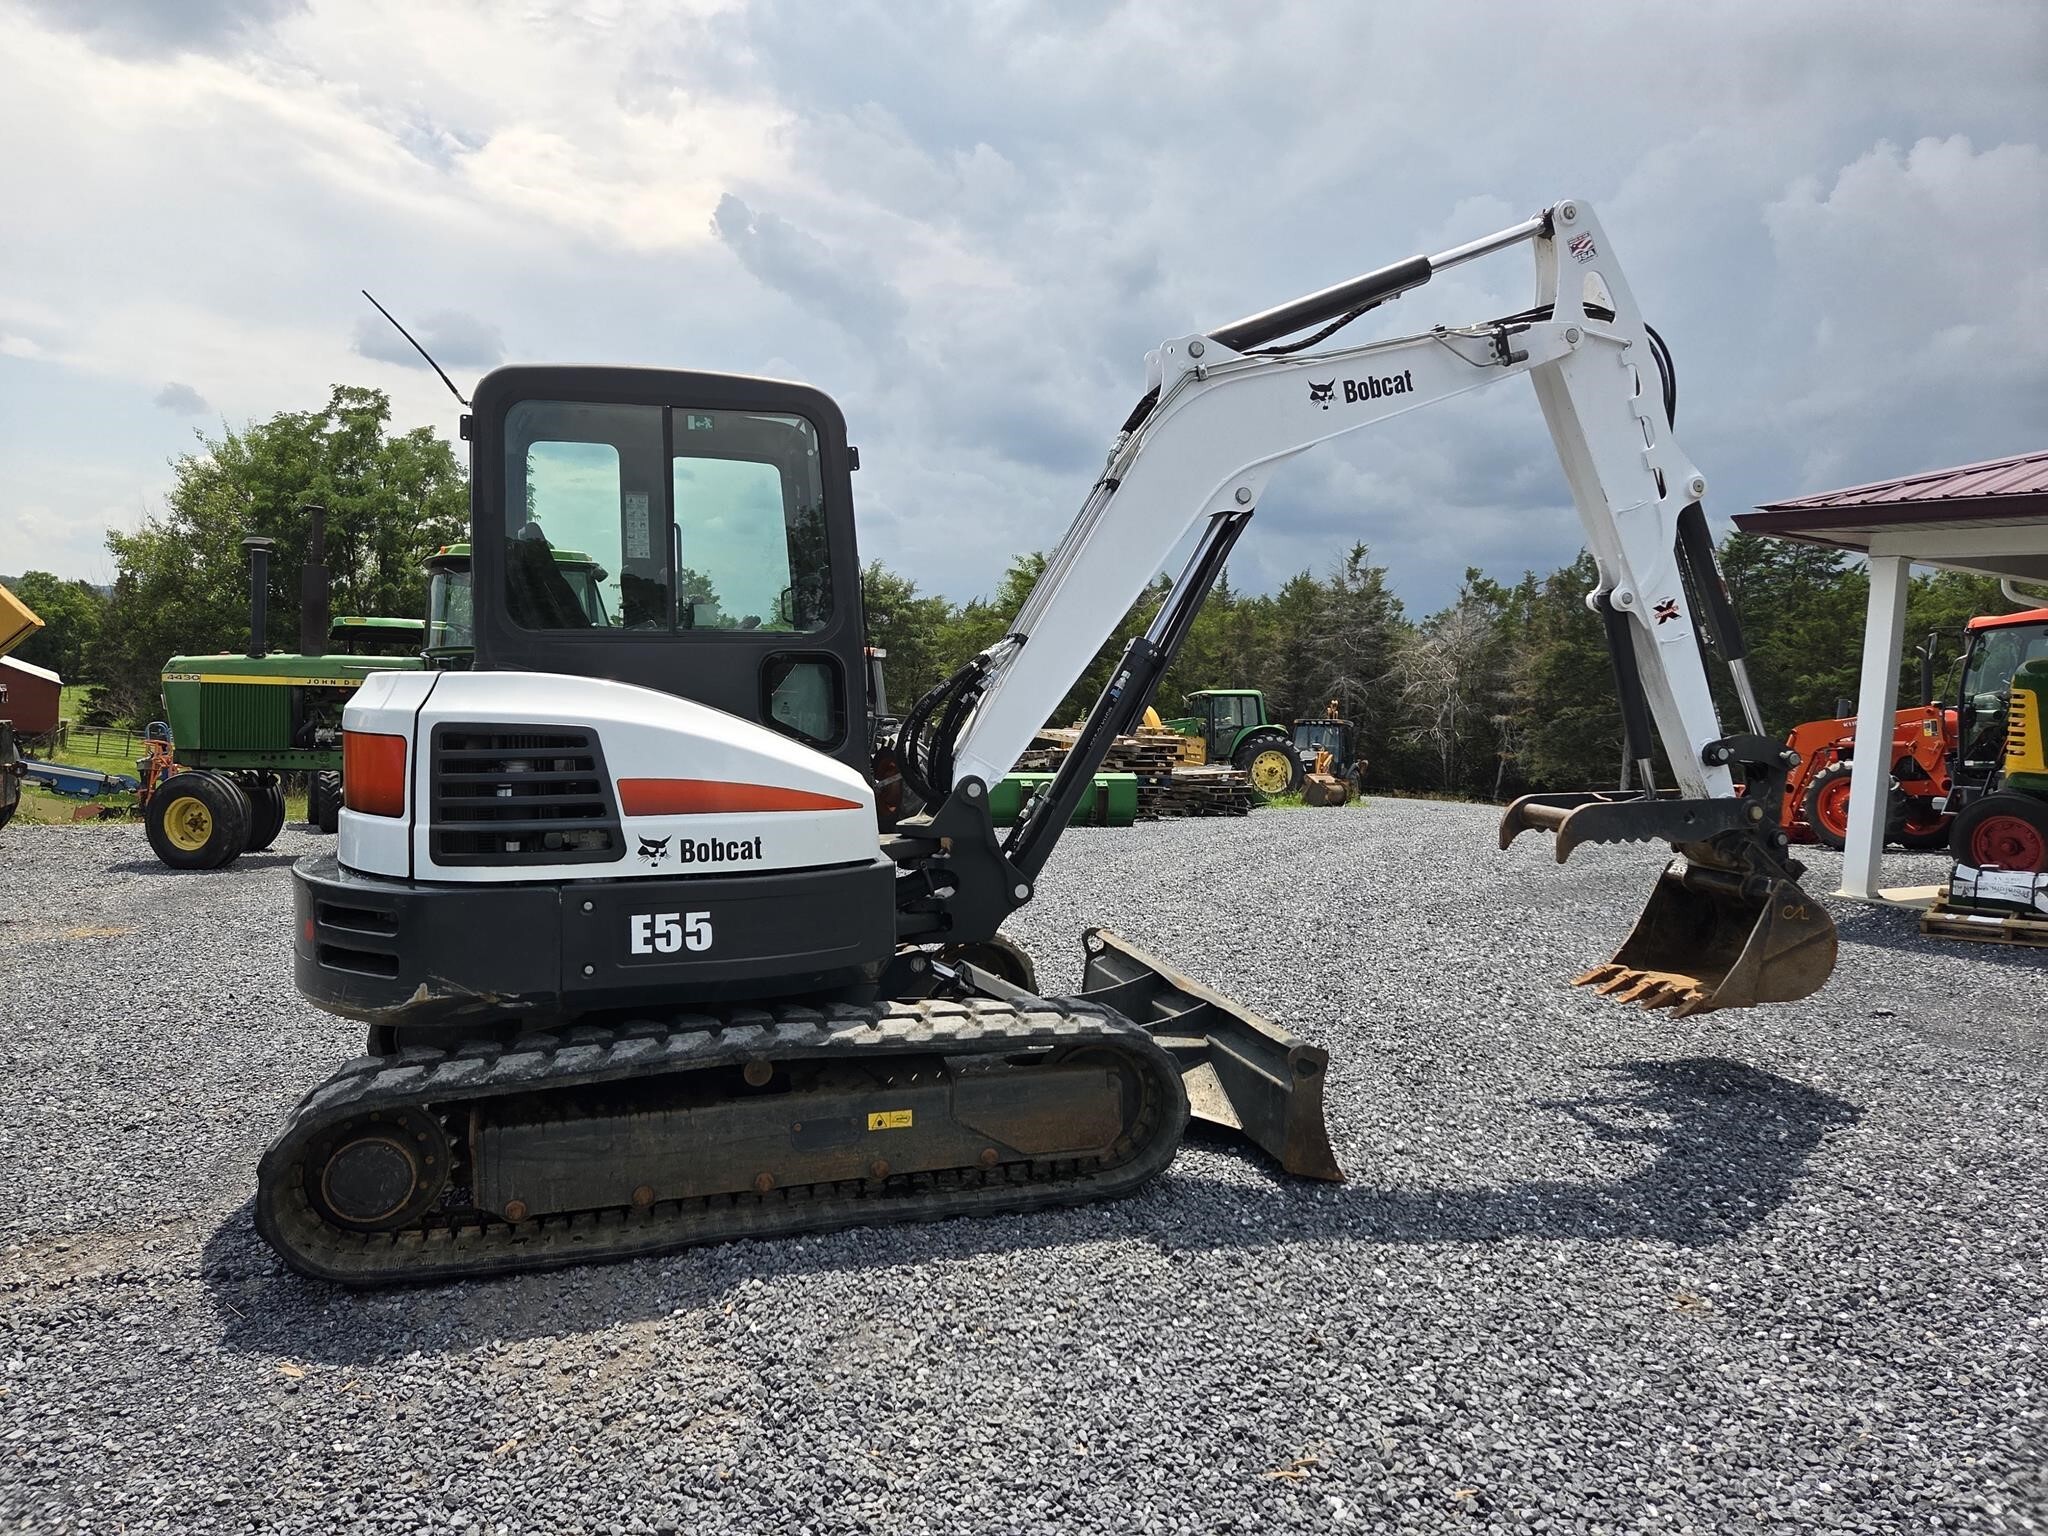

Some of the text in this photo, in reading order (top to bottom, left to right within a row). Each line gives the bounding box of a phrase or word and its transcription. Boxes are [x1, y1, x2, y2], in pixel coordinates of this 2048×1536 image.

[1343, 369, 1414, 404] Bobcat
[680, 836, 762, 863] Bobcat
[630, 911, 713, 955] E55
